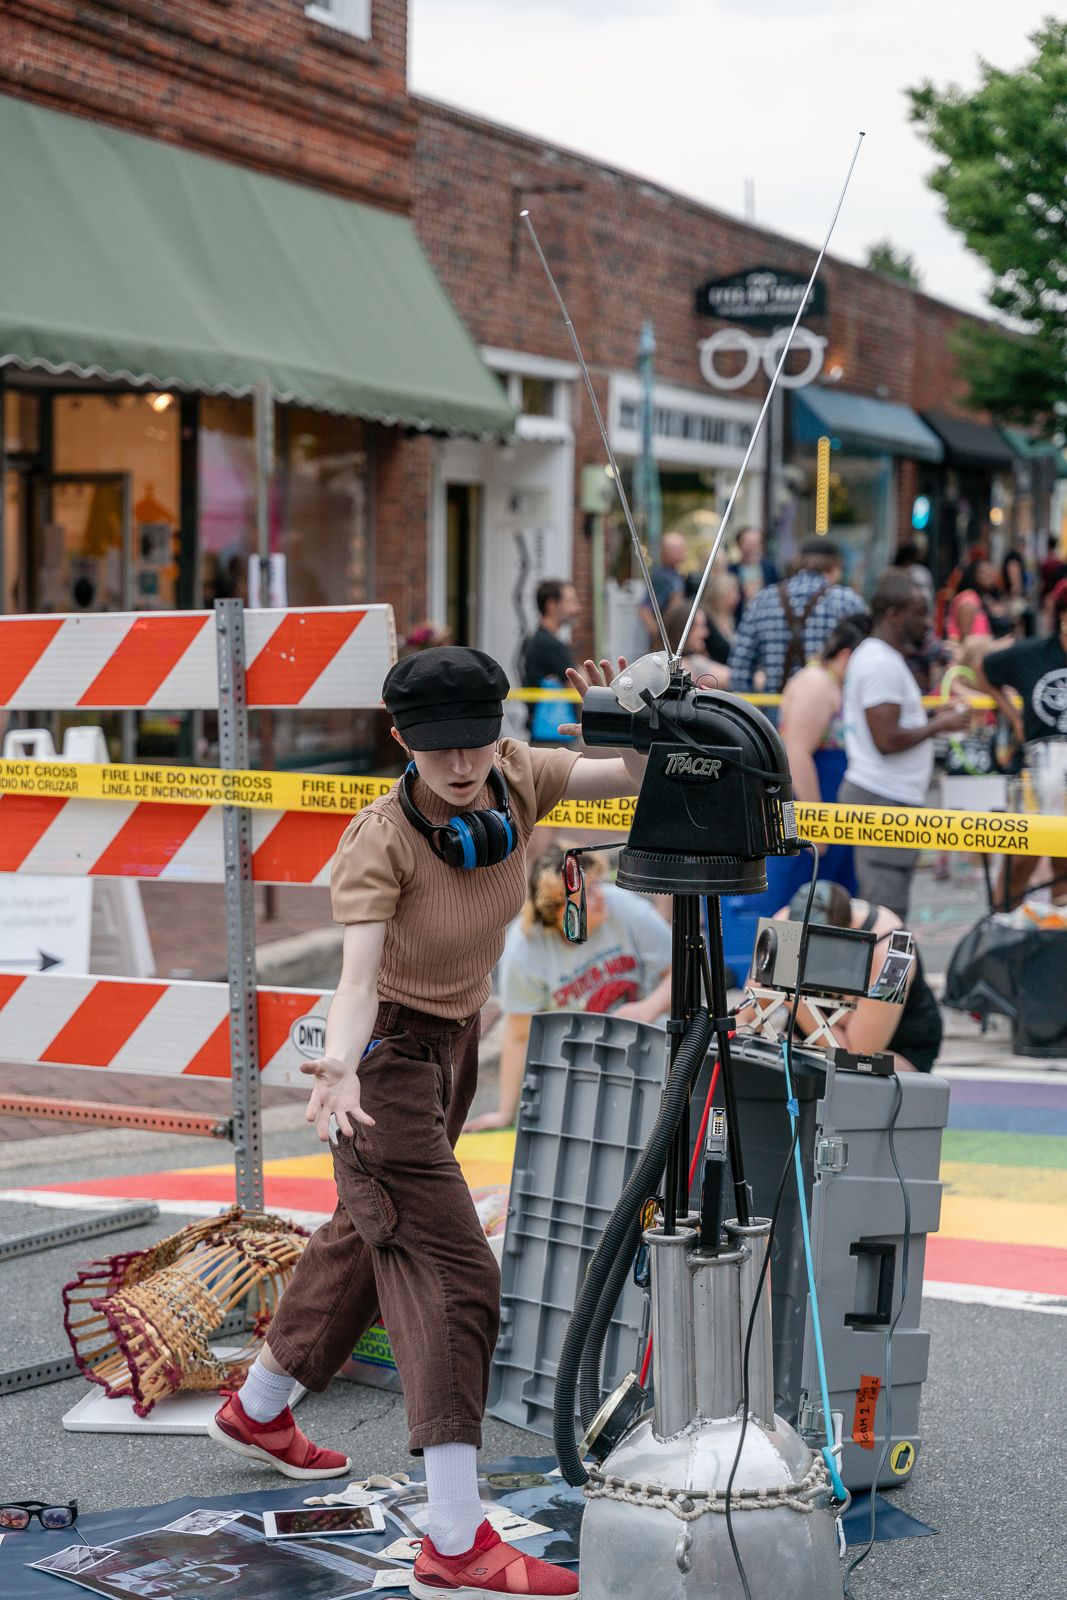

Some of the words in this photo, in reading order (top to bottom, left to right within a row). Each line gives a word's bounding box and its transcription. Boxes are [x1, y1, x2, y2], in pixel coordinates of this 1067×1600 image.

[6, 765, 30, 776] NOT
[34, 766, 77, 779] CROSS
[665, 752, 722, 779] TRACER
[21, 779, 35, 790] NO
[38, 780, 79, 792] CRUZAR
[102, 769, 130, 781] FIRE
[134, 771, 162, 783] LINE
[167, 772, 186, 784] DO
[190, 773, 218, 786] NOT
[222, 775, 272, 789] CROSS
[302, 780, 335, 793] FIRE
[340, 782, 374, 795] LINE
[380, 784, 390, 795] D
[102, 784, 131, 796] LINEA
[135, 785, 148, 797] DE
[152, 786, 203, 799] INCENDIO
[206, 788, 221, 800] NO
[224, 790, 273, 803] CRUZAR
[301, 795, 337, 808] LINEA
[340, 796, 356, 809] DE
[545, 810, 571, 822] NEA
[575, 812, 593, 824] DE
[598, 812, 634, 826] INCE
[835, 810, 876, 825] LINE
[882, 813, 909, 827] DO
[915, 814, 956, 829] NOT
[961, 817, 1029, 833] CROSS
[797, 825, 829, 838] INEA
[834, 826, 854, 840] DE
[858, 827, 932, 844] INCENDIO
[937, 832, 958, 846] NO
[963, 833, 1029, 850] CRUZAR
